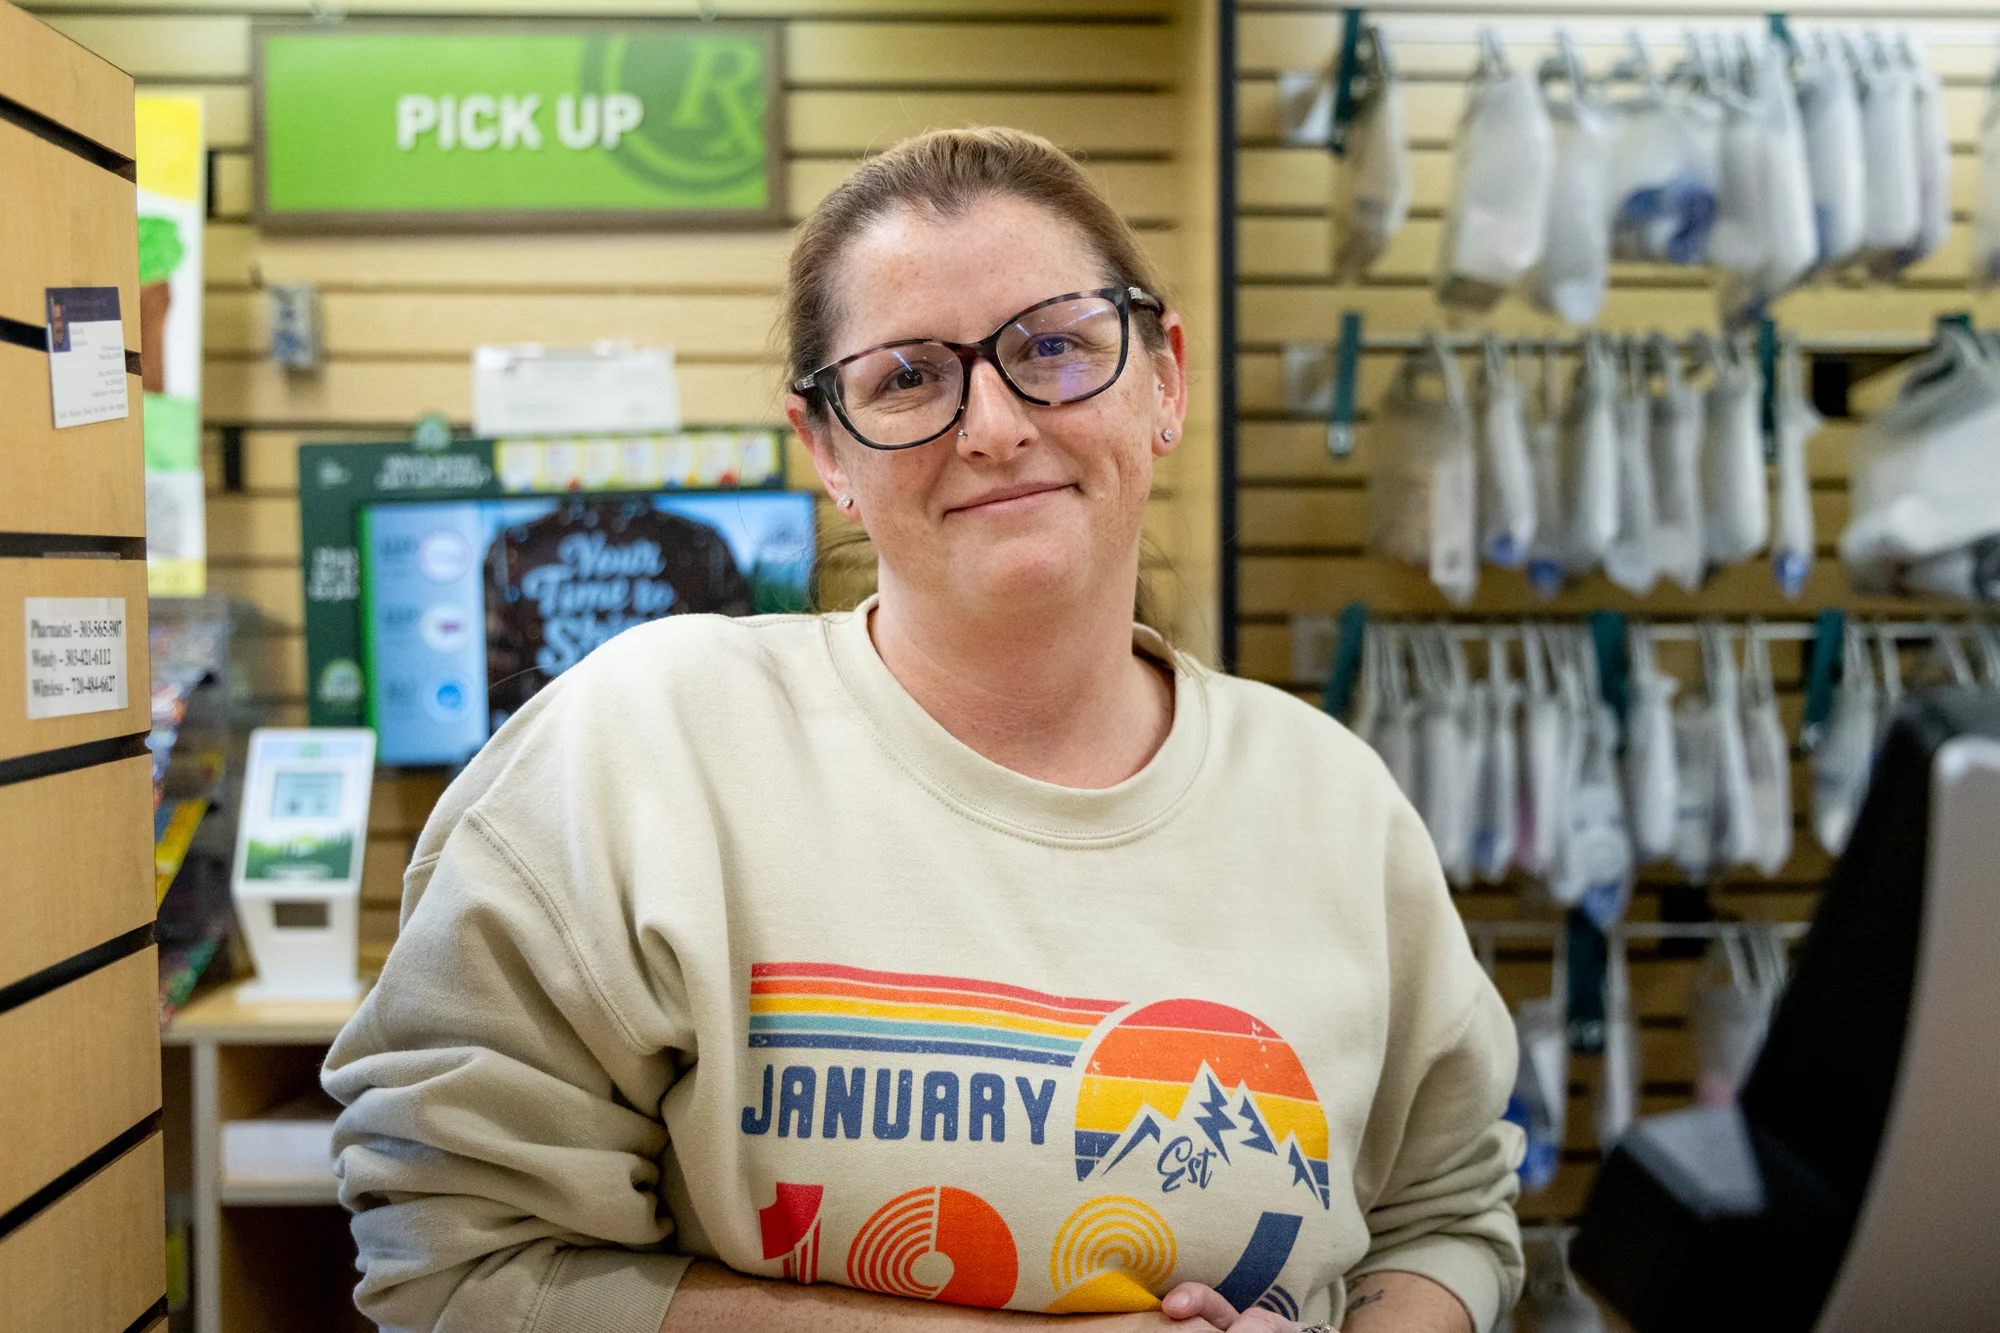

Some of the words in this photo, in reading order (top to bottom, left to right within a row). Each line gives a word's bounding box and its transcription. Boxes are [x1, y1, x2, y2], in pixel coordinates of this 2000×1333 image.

[397, 93, 543, 151] PICK
[556, 93, 645, 151] UP
[558, 530, 667, 578] Your
[521, 564, 630, 621] Time
[633, 576, 676, 616] to
[741, 1064, 1057, 1145] JANUARY
[1157, 1136, 1216, 1192] Est
